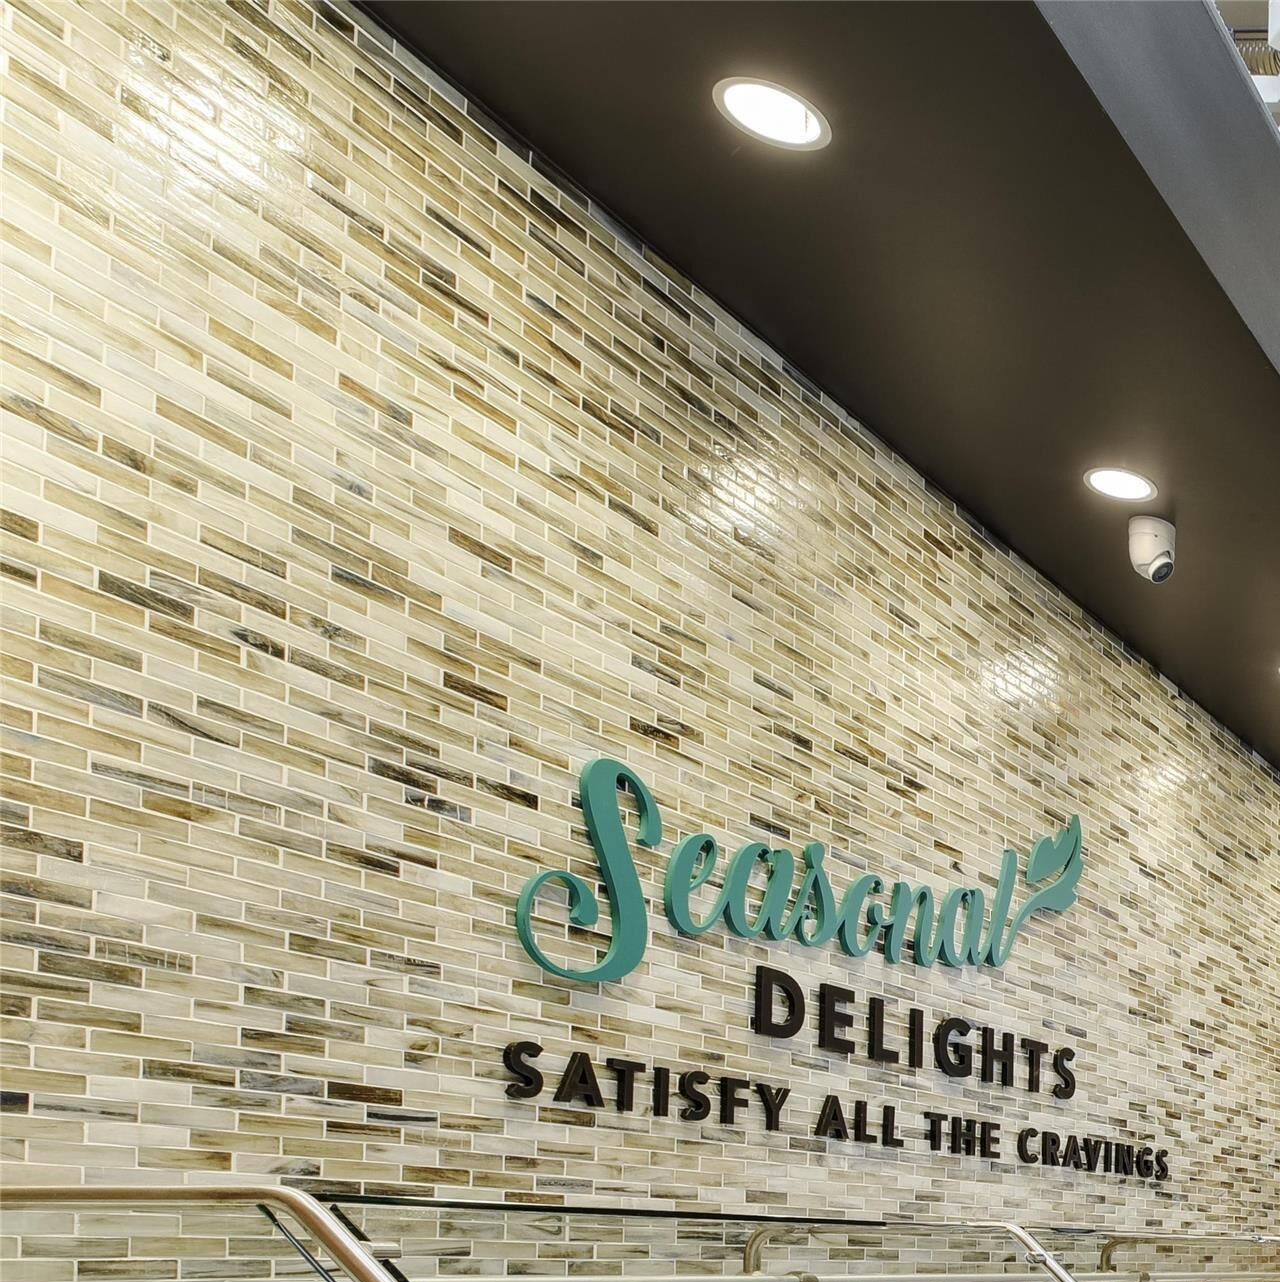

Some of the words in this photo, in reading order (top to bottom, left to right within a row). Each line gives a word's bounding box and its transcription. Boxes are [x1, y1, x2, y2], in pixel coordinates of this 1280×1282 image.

[516, 758, 1032, 982] Seasonal
[753, 965, 1076, 1099] DELIGHTS
[503, 1041, 791, 1131] SATISFY
[815, 1095, 904, 1148] ALL
[924, 1111, 1001, 1158] THE
[1017, 1128, 1168, 1180] CRAVINGS
